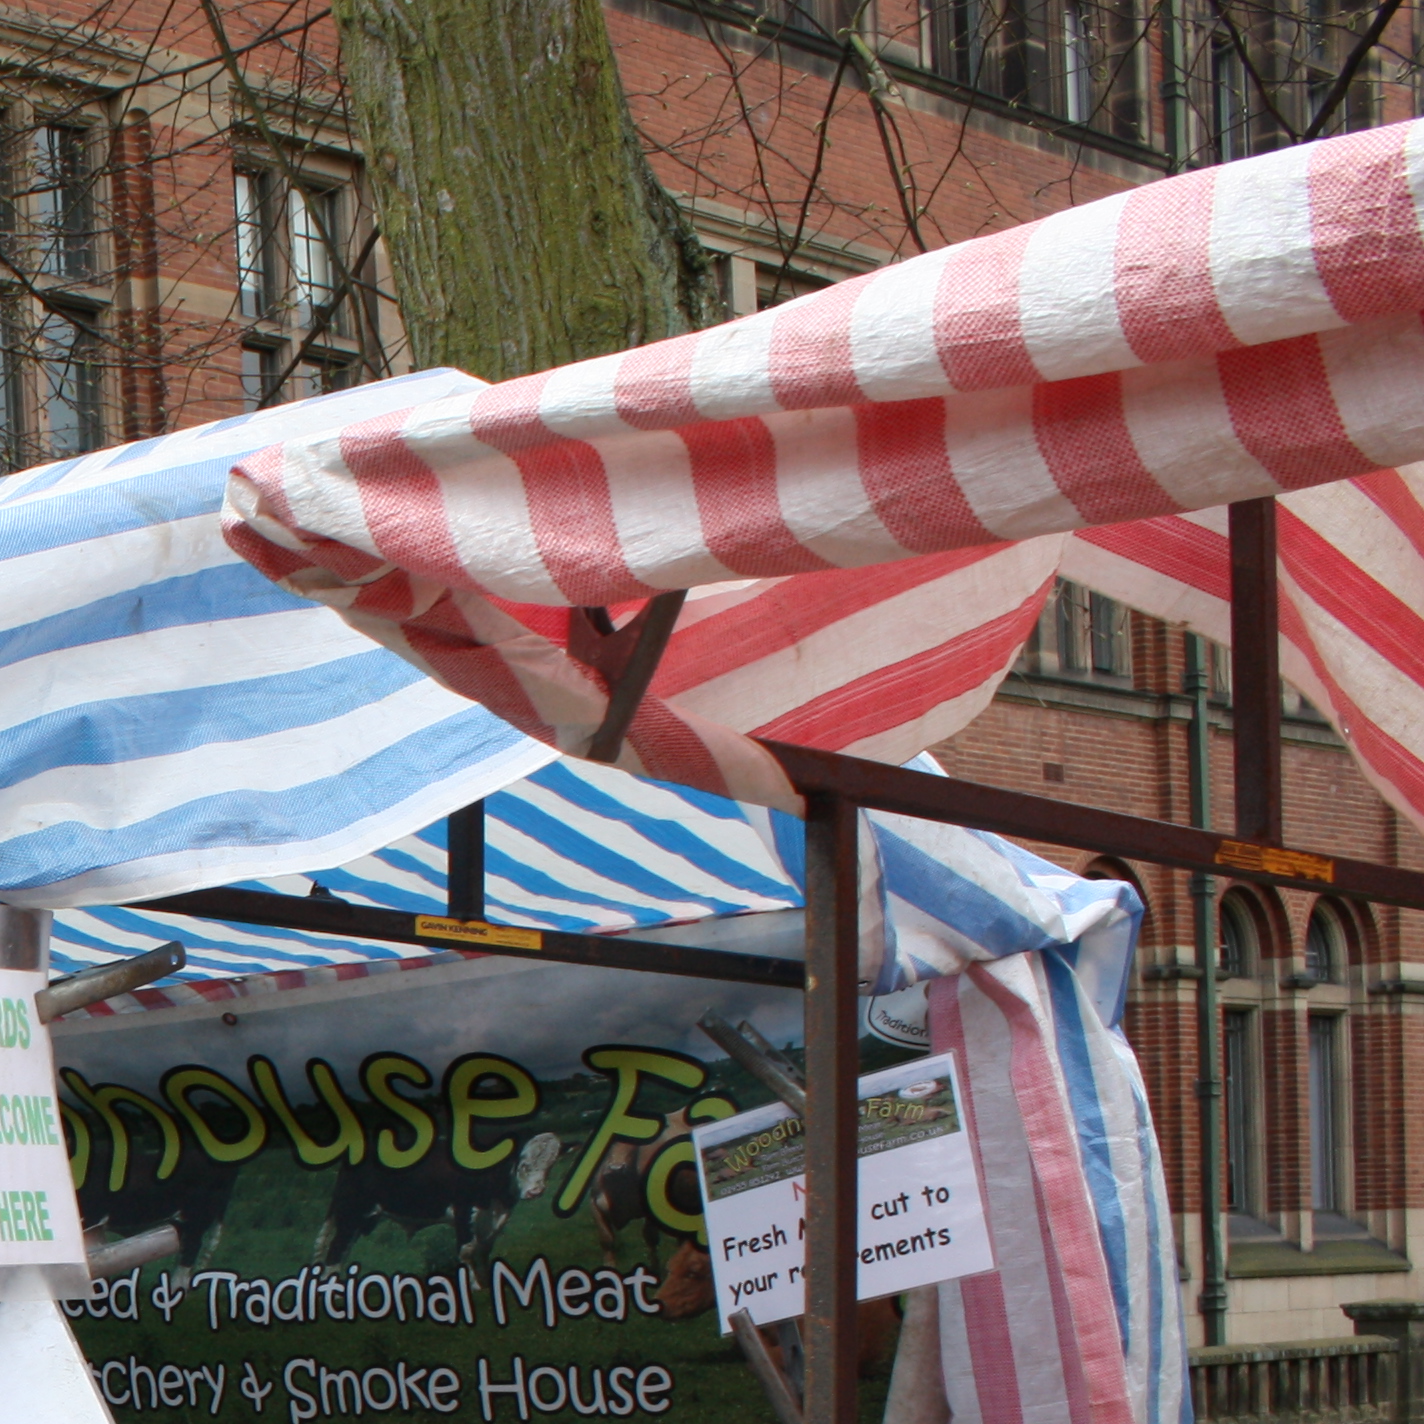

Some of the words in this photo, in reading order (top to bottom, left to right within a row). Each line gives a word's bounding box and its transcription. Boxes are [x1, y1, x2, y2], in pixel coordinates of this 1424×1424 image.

[866, 1098, 925, 1120] Farm
[723, 1224, 787, 1262] Fresh
[870, 1192, 909, 1221] cut
[921, 1185, 950, 1207] to
[152, 1272, 181, 1323] &
[191, 1264, 474, 1329] Traditional
[492, 1257, 660, 1327] Meat
[729, 1270, 778, 1305] your
[240, 1361, 273, 1412] &
[478, 1355, 672, 1422] House
